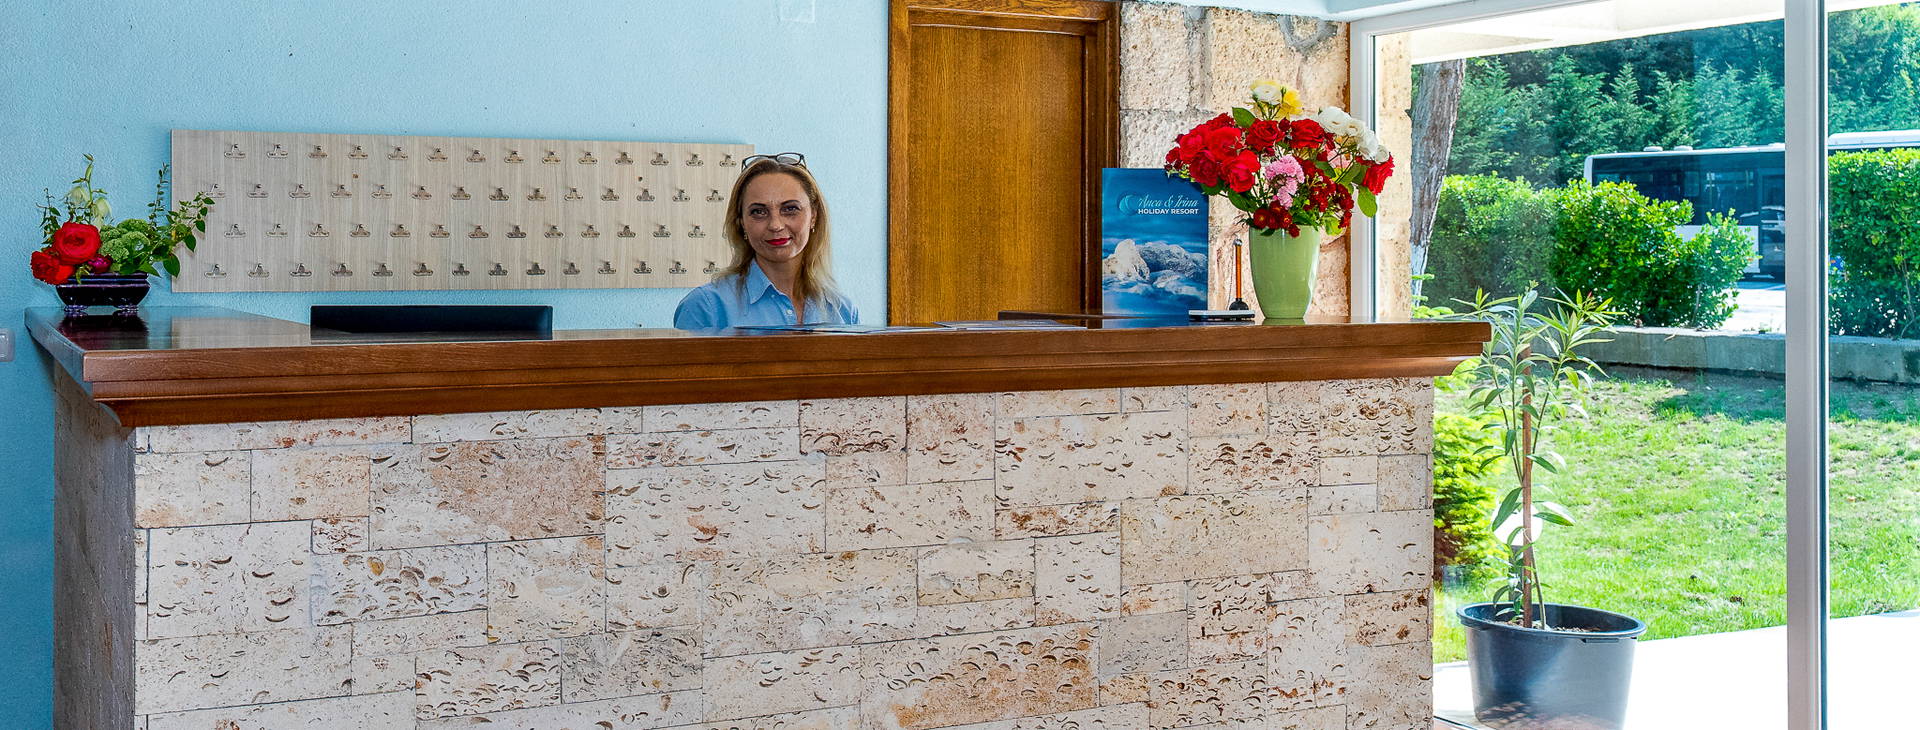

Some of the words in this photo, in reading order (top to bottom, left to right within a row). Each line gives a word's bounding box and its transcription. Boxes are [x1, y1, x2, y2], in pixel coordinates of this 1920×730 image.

[1138, 194, 1161, 208] Anca
[1164, 195, 1174, 208] &
[1174, 195, 1199, 207] Irina
